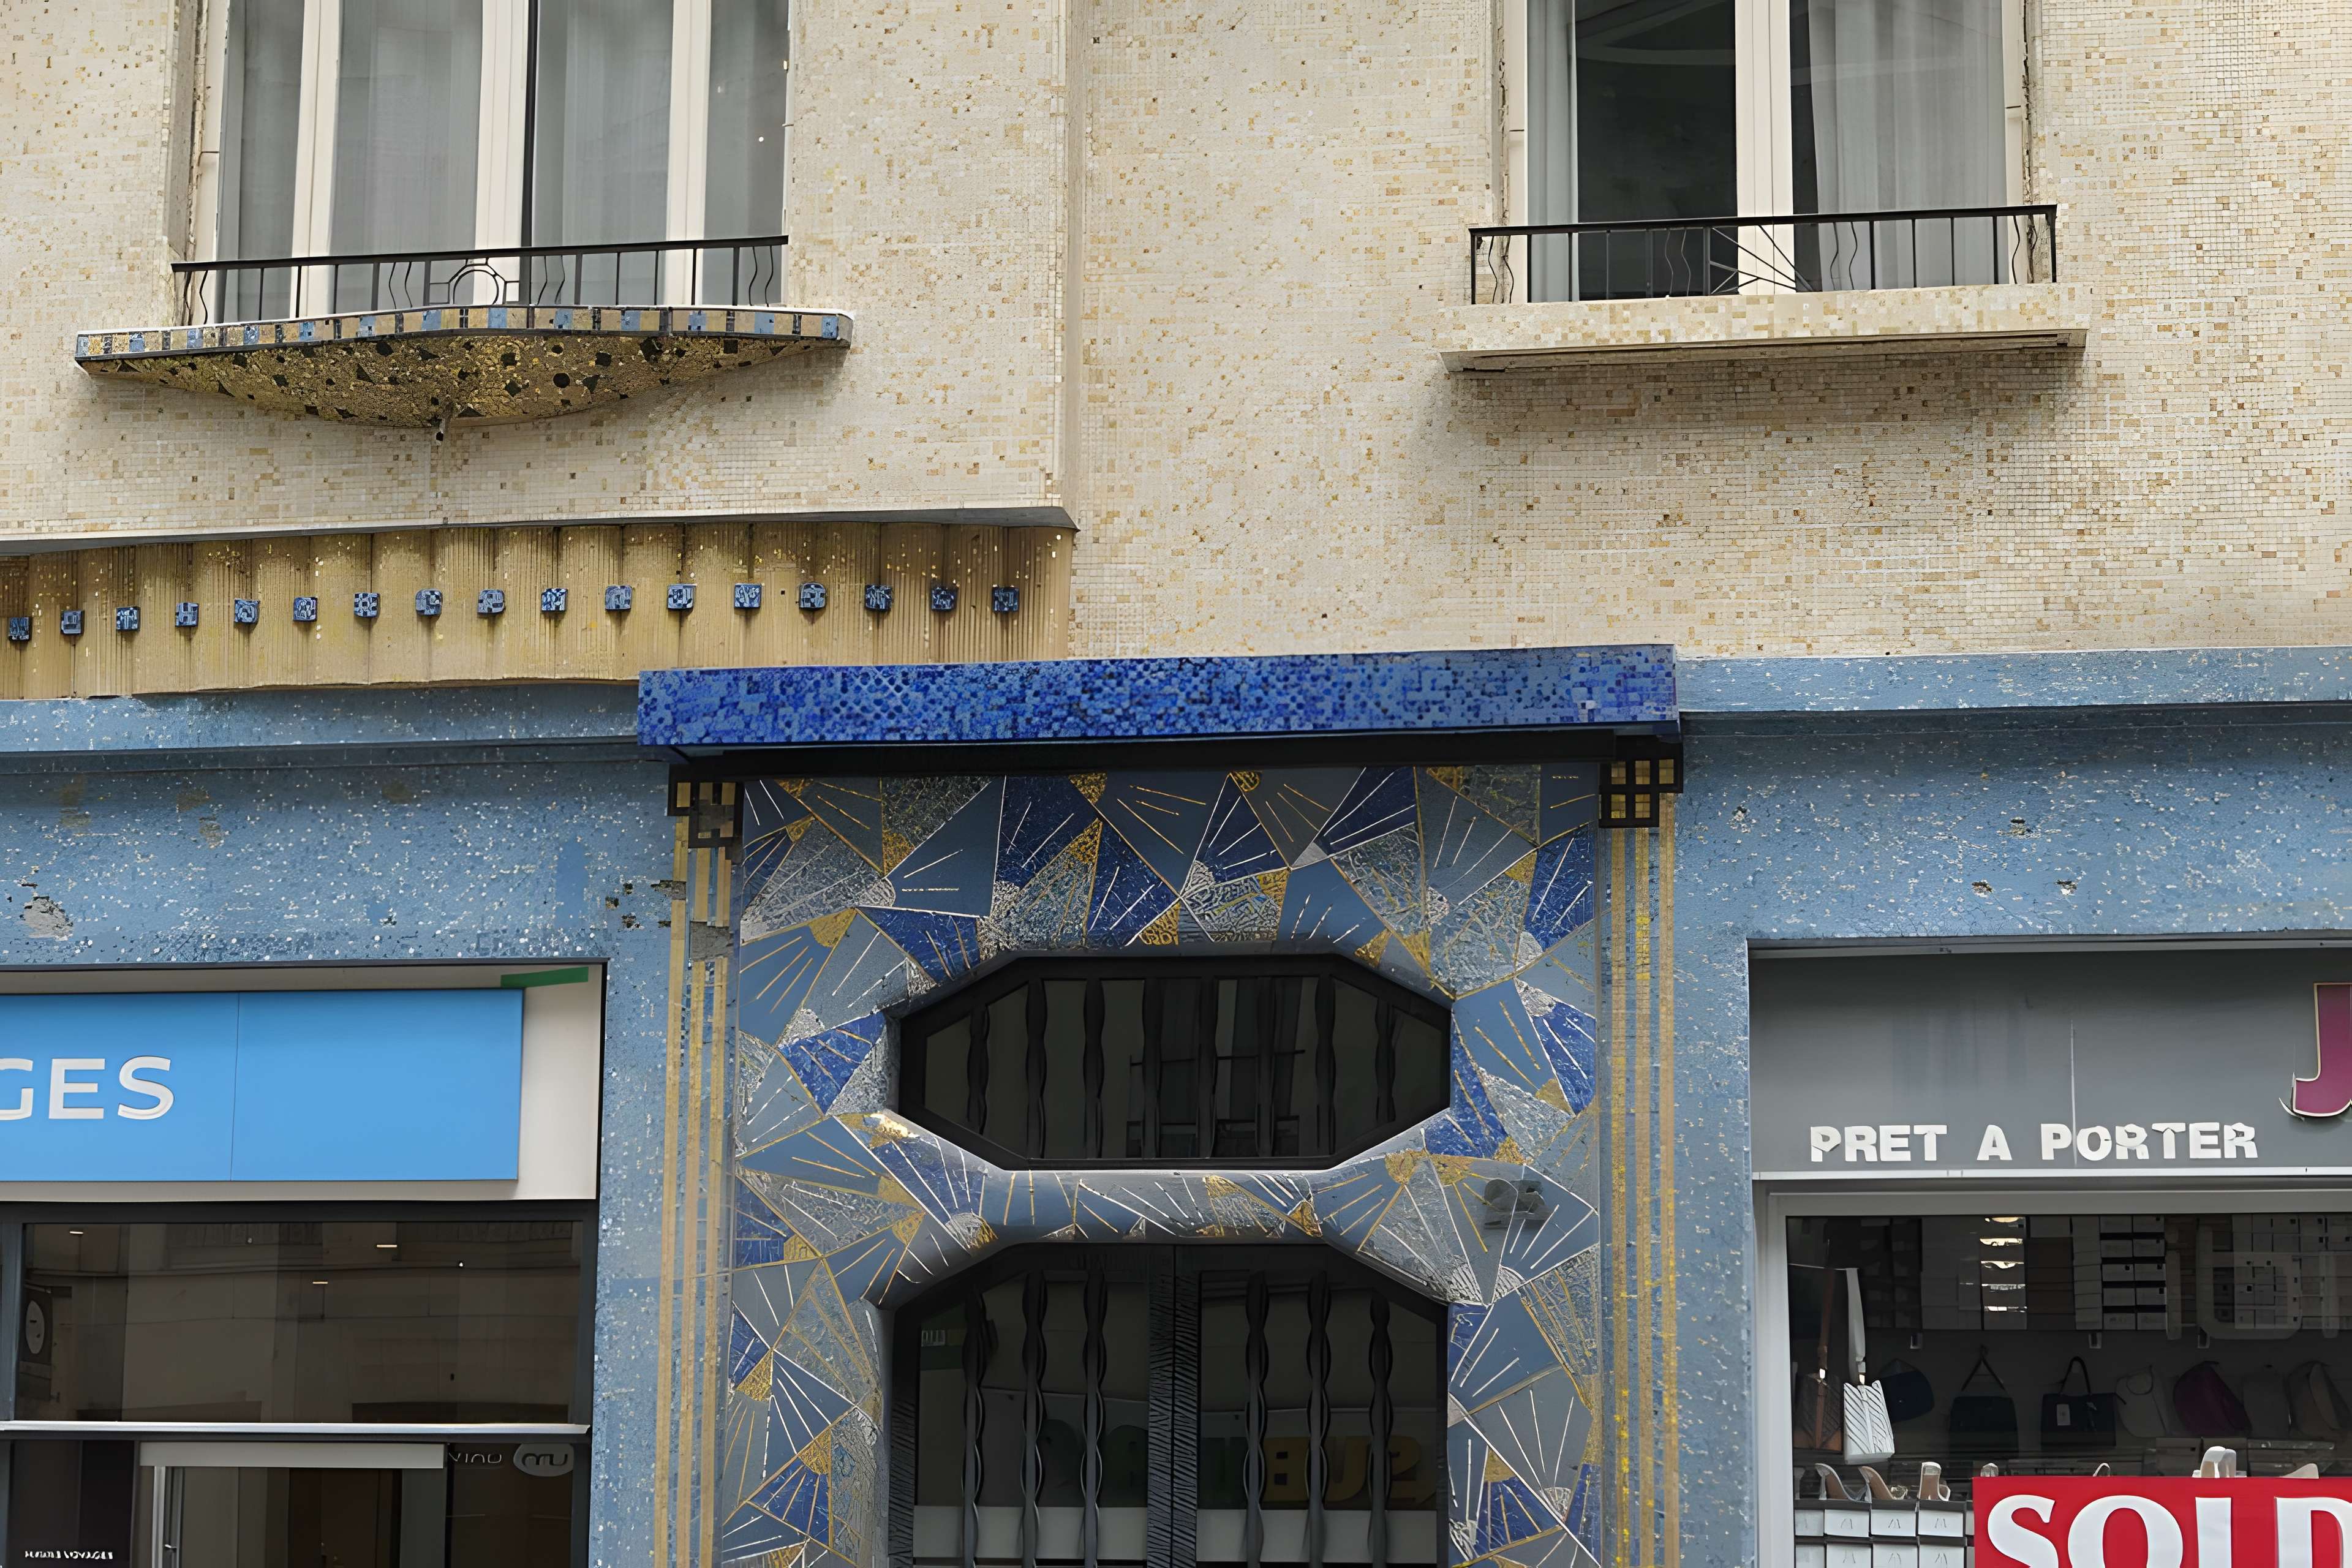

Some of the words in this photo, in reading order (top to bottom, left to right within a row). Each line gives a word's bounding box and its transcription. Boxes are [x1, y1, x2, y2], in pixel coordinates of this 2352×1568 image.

[1811, 1125, 1947, 1162] PRET
[1977, 1124, 2013, 1161] A
[2040, 1122, 2258, 1161] PORTER
